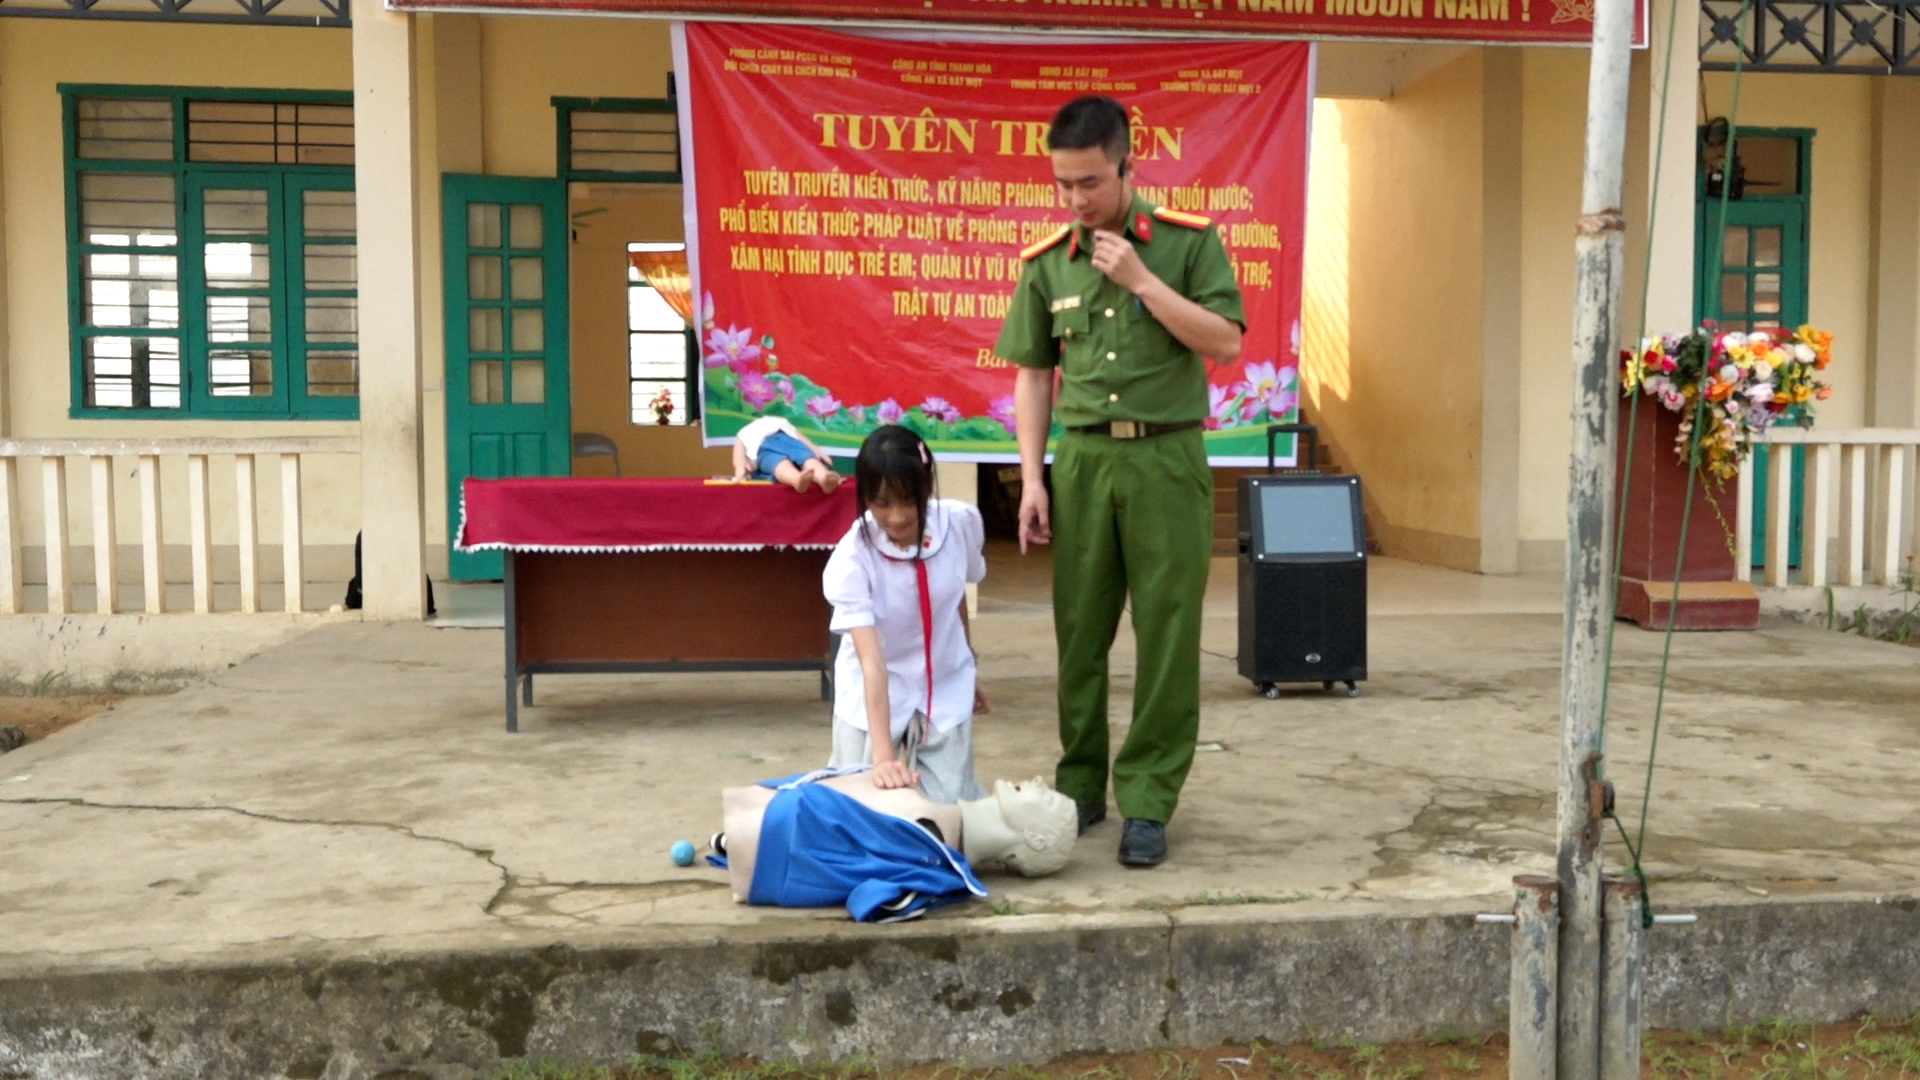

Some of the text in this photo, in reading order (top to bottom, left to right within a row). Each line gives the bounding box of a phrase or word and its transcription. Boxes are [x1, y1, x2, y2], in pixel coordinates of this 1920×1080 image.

[813, 105, 1184, 161] TUYÊN TRỀN
[744, 166, 790, 196] TUYÊN
[793, 165, 850, 198] TRUYỀN
[854, 169, 889, 200] KIẾN
[937, 175, 957, 205] KỸ
[960, 176, 1002, 207] NĂNG
[1005, 177, 1055, 208] PHÒNG
[1172, 178, 1206, 211] ĐUỐI
[719, 199, 746, 232] PHỔ
[749, 202, 779, 235] BIẾN
[782, 203, 818, 236] KIẾN
[822, 206, 860, 237] THỨC
[863, 208, 904, 238] PHÁP
[907, 211, 942, 245] LUẬT
[946, 210, 964, 242] VỀ
[968, 214, 1017, 244] PHÒNG
[1021, 214, 1067, 244] CHỐ
[730, 240, 760, 271] XÂM
[762, 248, 785, 278] HẠI
[787, 244, 820, 275] TÌNH
[824, 250, 854, 281] DỤC
[858, 244, 885, 277] TRẺ
[921, 247, 961, 281] QUẢN
[965, 251, 981, 281] LÝ
[985, 252, 1004, 282] VŨ
[892, 286, 929, 322] TRẬT
[932, 290, 953, 322] TỰ
[954, 293, 975, 317] AN
